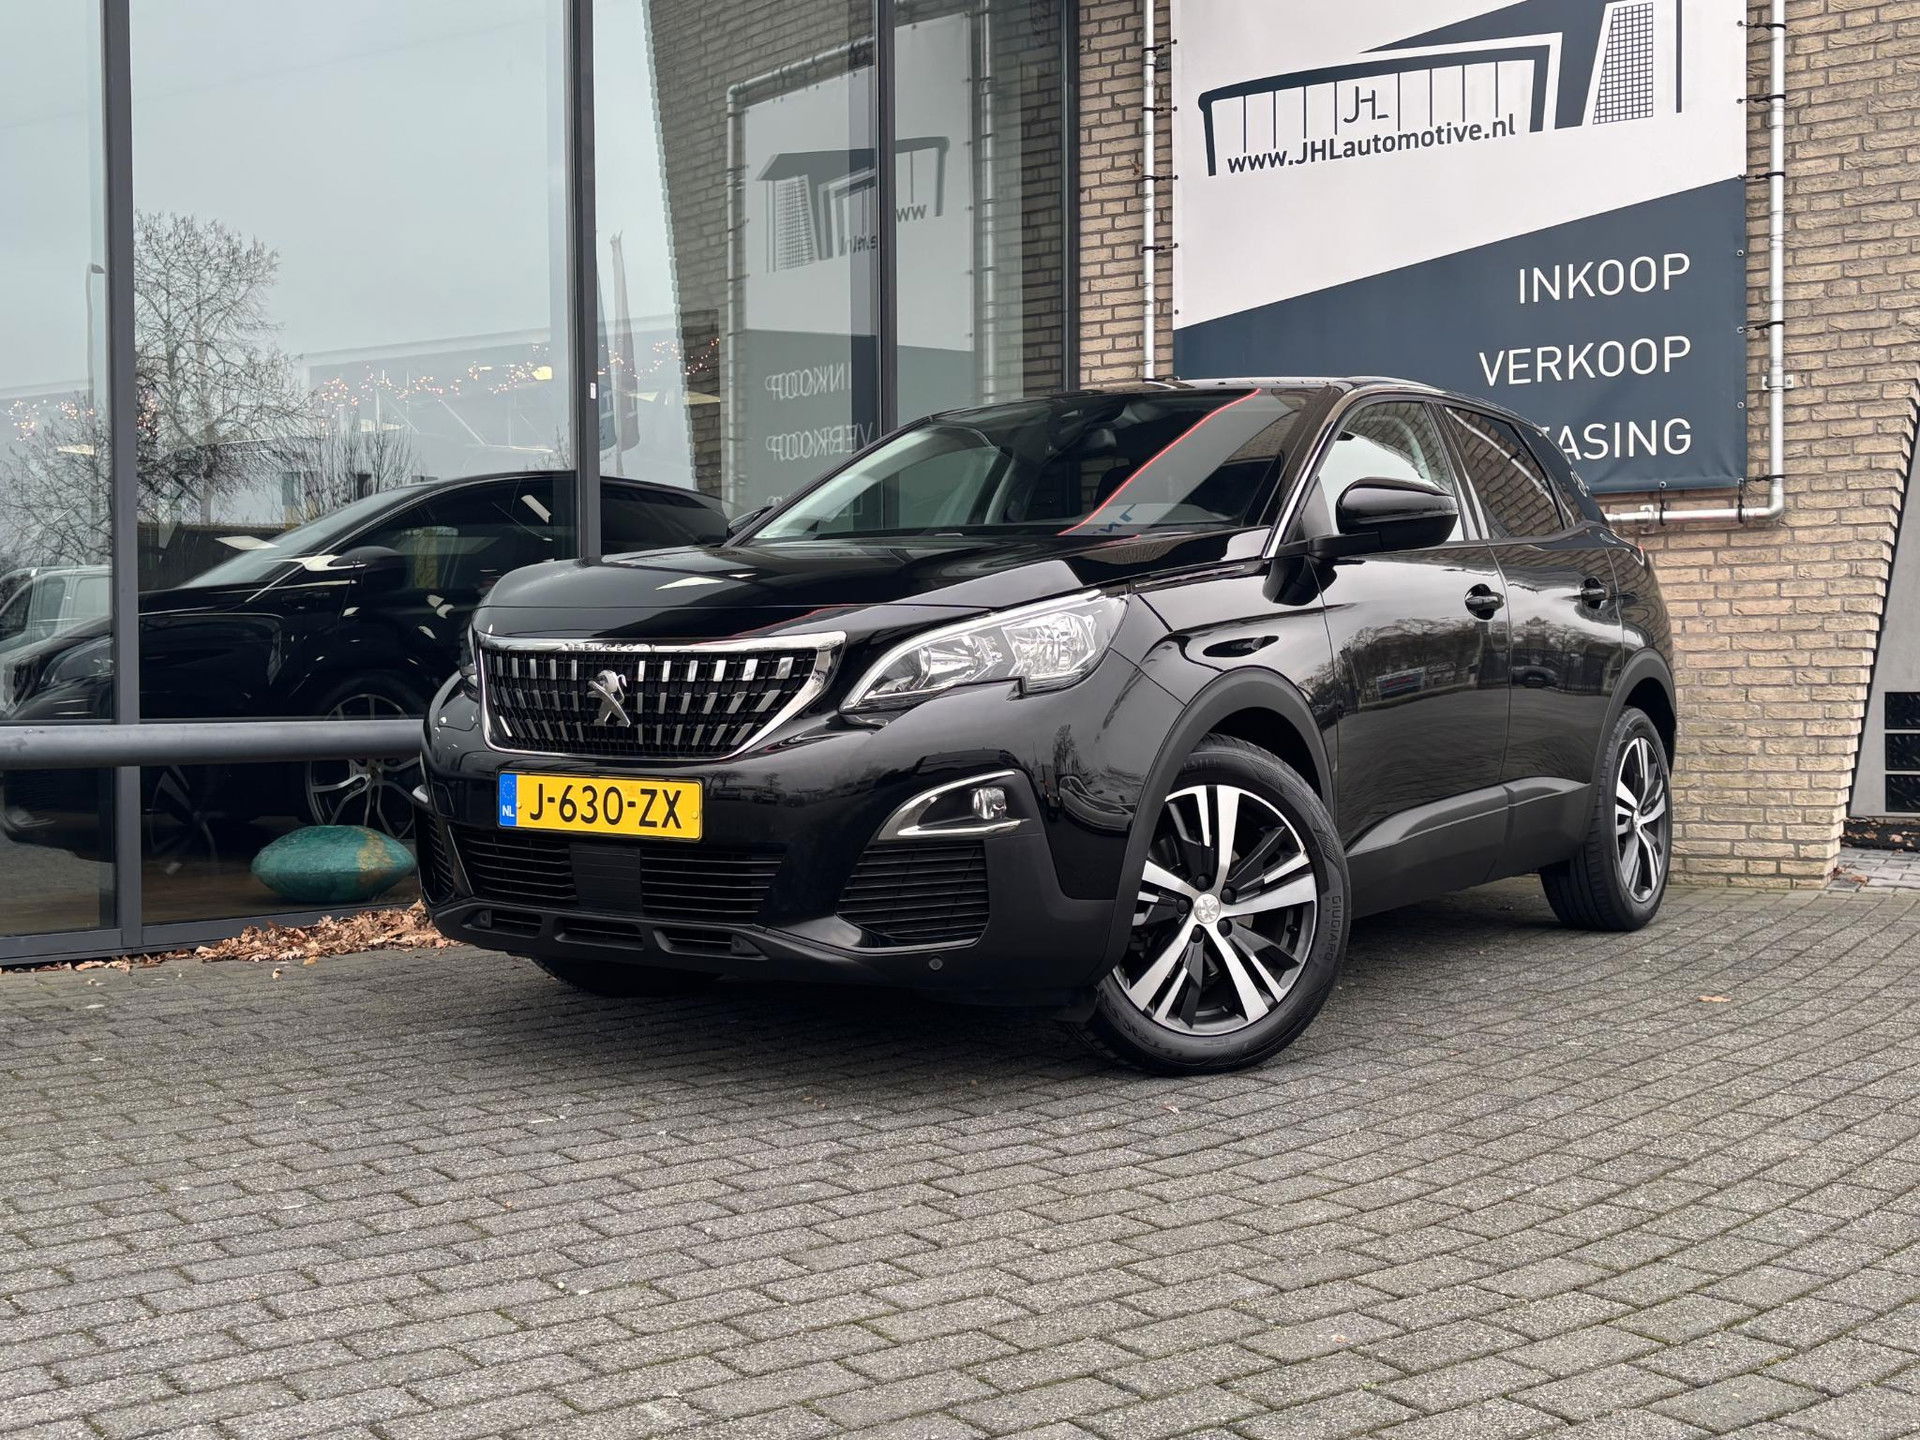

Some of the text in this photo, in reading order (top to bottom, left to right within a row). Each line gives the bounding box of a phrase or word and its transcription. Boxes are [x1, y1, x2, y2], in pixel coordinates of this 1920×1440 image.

[1227, 113, 1516, 173] www.JHLautomotive.nl
[1519, 252, 1690, 304] INKOOP
[1479, 335, 1691, 387] VERKOOP
[1540, 417, 1691, 461] ASING
[502, 804, 515, 817] NL
[529, 783, 682, 829] J-630-ZX
